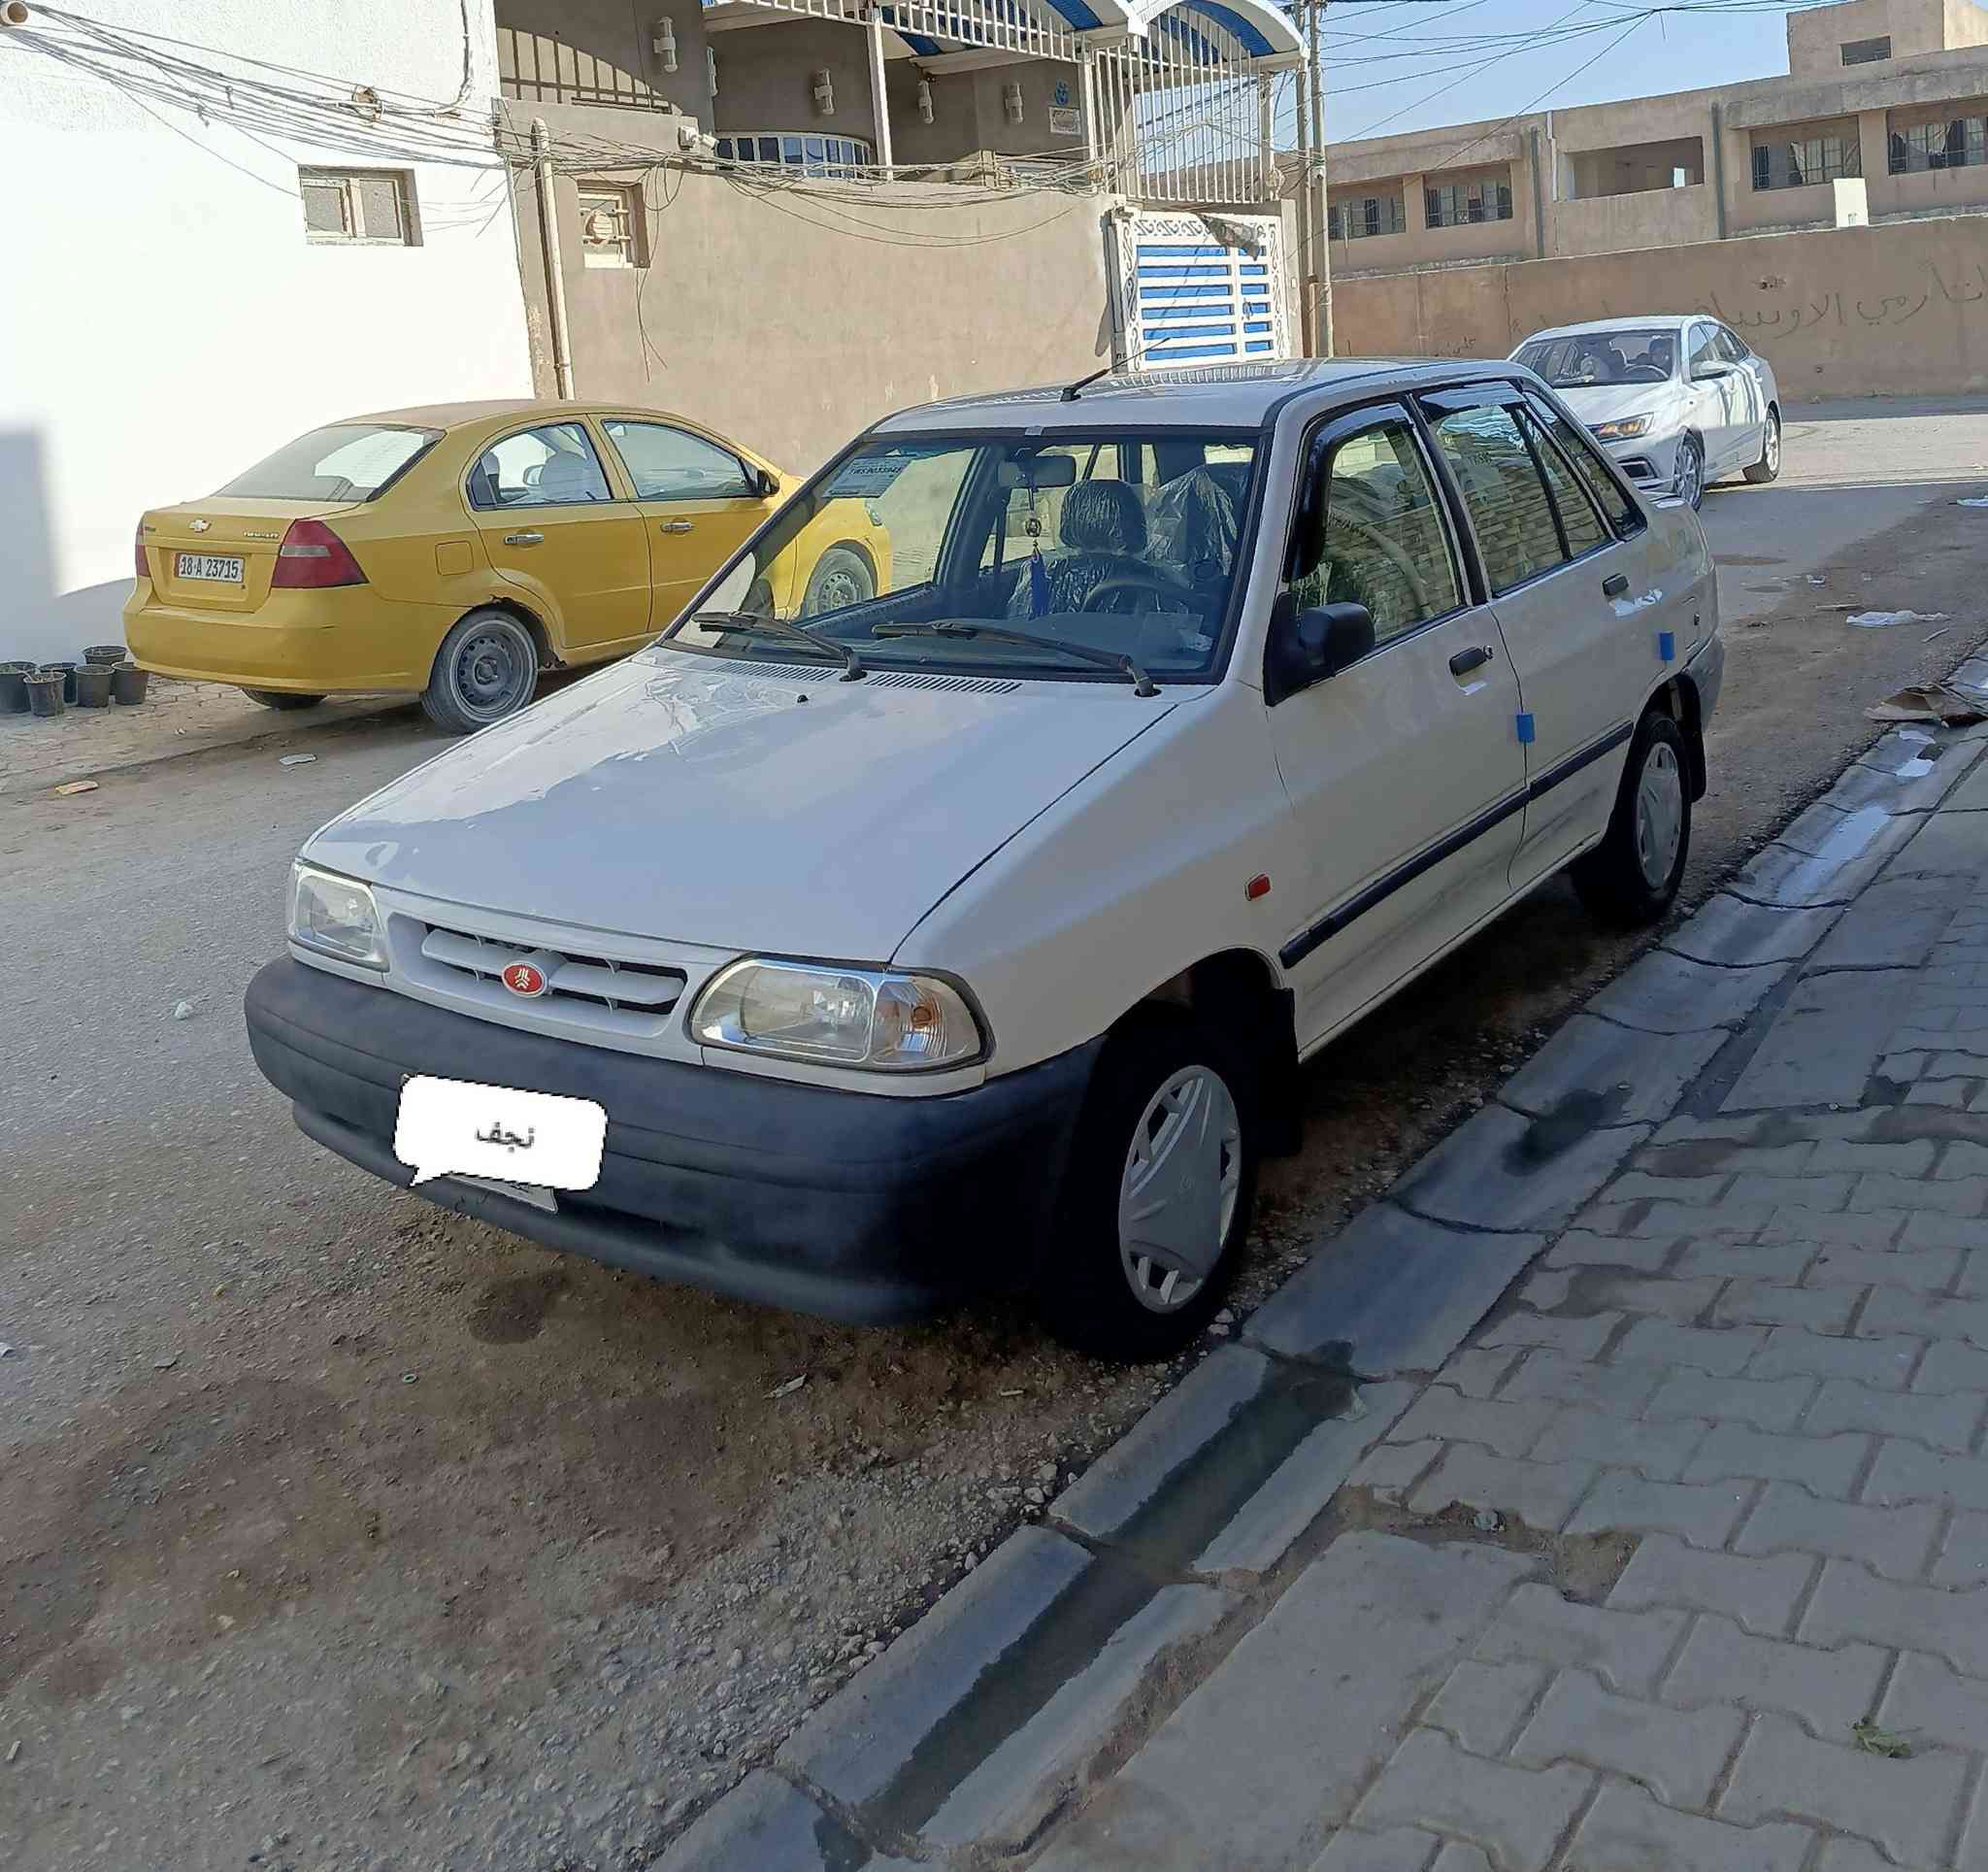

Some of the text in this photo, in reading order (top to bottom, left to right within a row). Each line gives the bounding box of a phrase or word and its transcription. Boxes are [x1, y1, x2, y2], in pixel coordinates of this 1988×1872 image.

[1693, 290, 1843, 340] الاوسا
[1856, 294, 1928, 327] رمي
[181, 556, 240, 579] 18 A 23715
